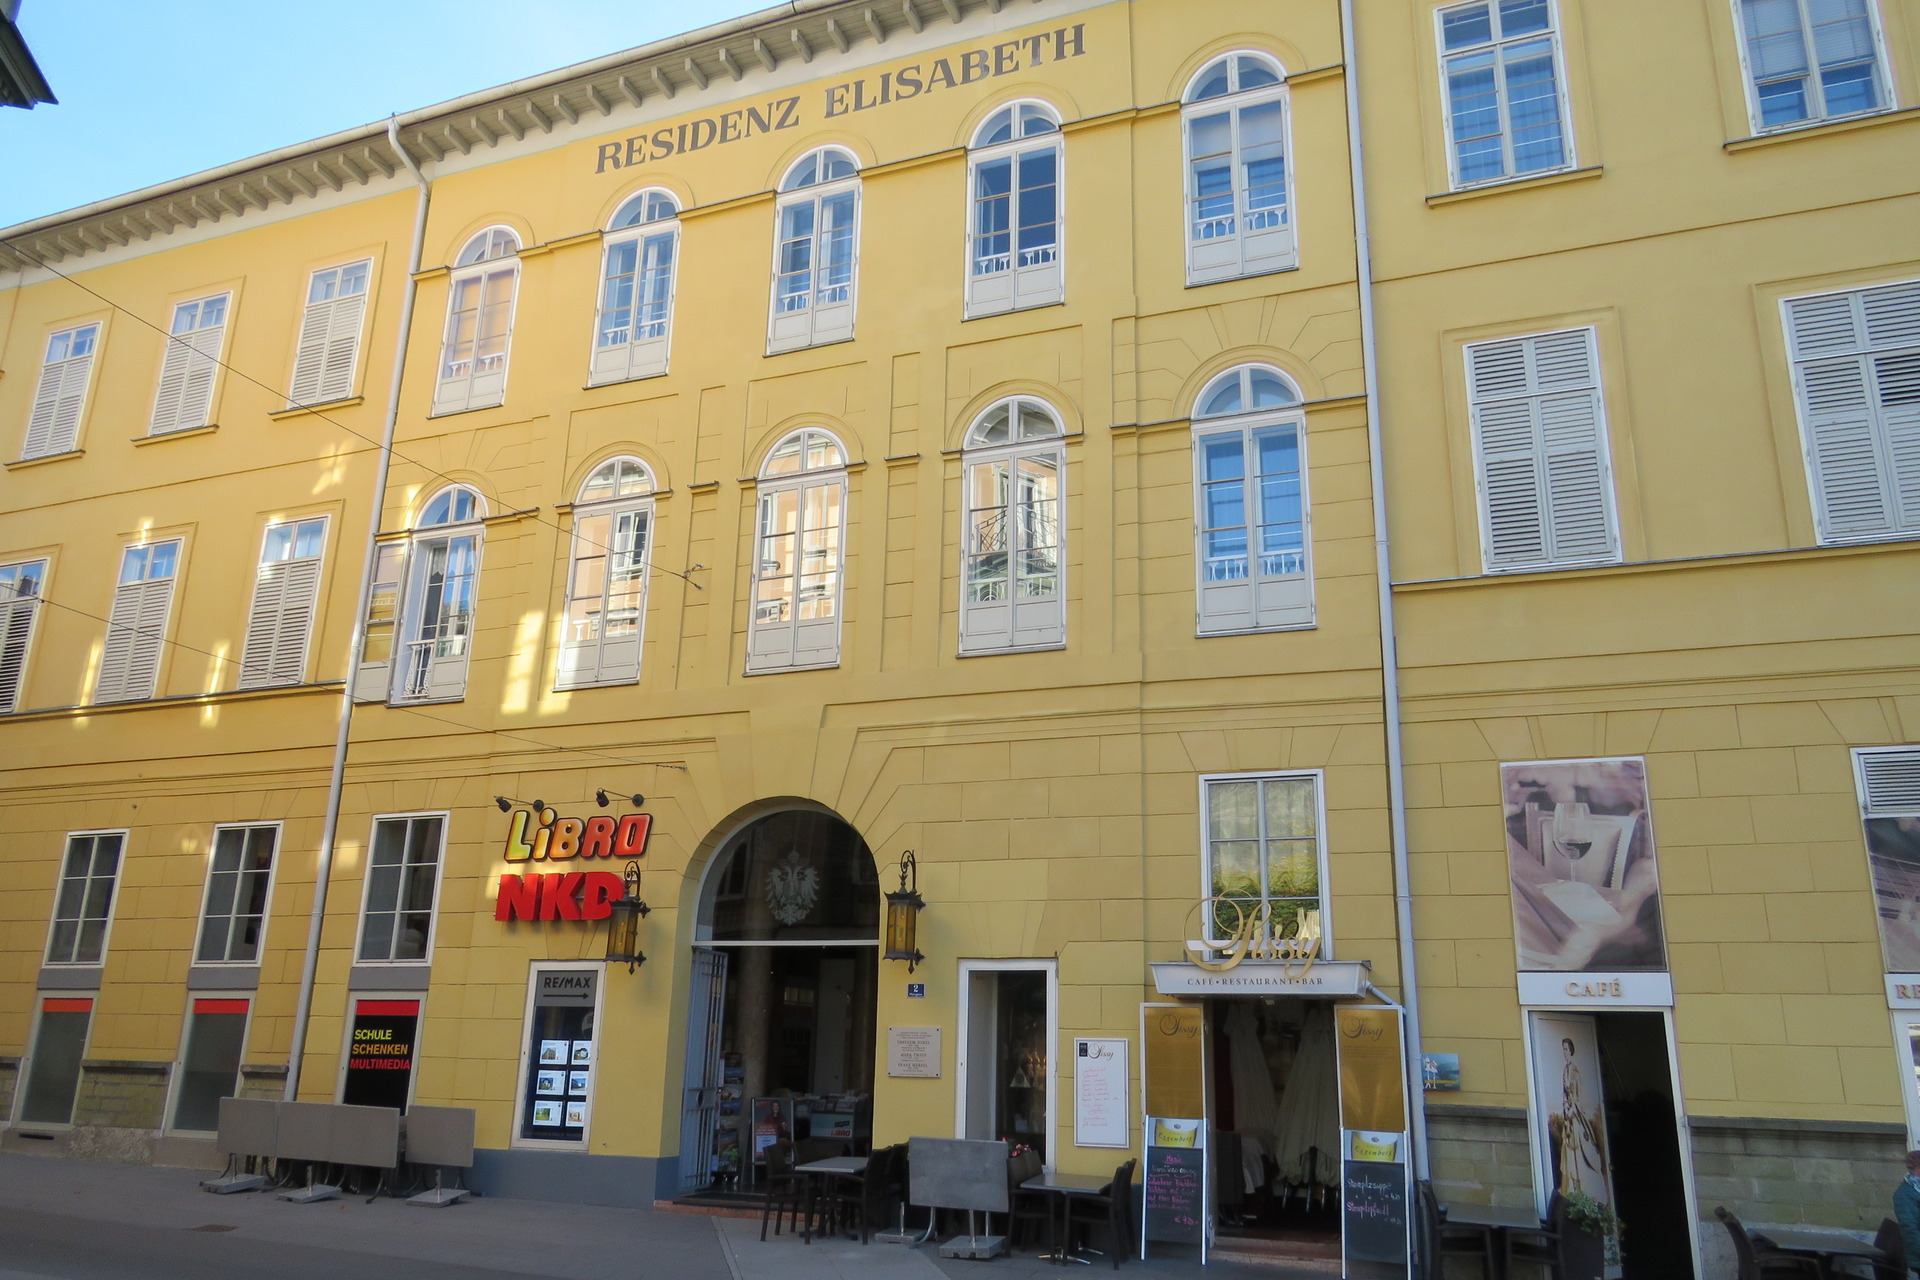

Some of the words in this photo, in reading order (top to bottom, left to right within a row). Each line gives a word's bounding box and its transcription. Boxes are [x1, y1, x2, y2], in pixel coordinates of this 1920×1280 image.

[595, 95, 801, 174] RESIDENZ
[824, 23, 1086, 119] ELISABETH
[495, 871, 626, 921] NKD
[1183, 889, 1321, 979] Sissy
[543, 976, 591, 989] RE/MAX
[913, 984, 919, 993] 2
[1302, 978, 1324, 986] BAR
[1566, 977, 1621, 997] CAFÉ
[1159, 1013, 1200, 1038] Sissy
[1342, 1016, 1383, 1041] Sissy
[354, 1029, 393, 1040] SCHULE
[352, 1043, 409, 1055] SCHENKEN
[1088, 1043, 1114, 1060] Sissy
[349, 1058, 411, 1069] MULTIMEDIA
